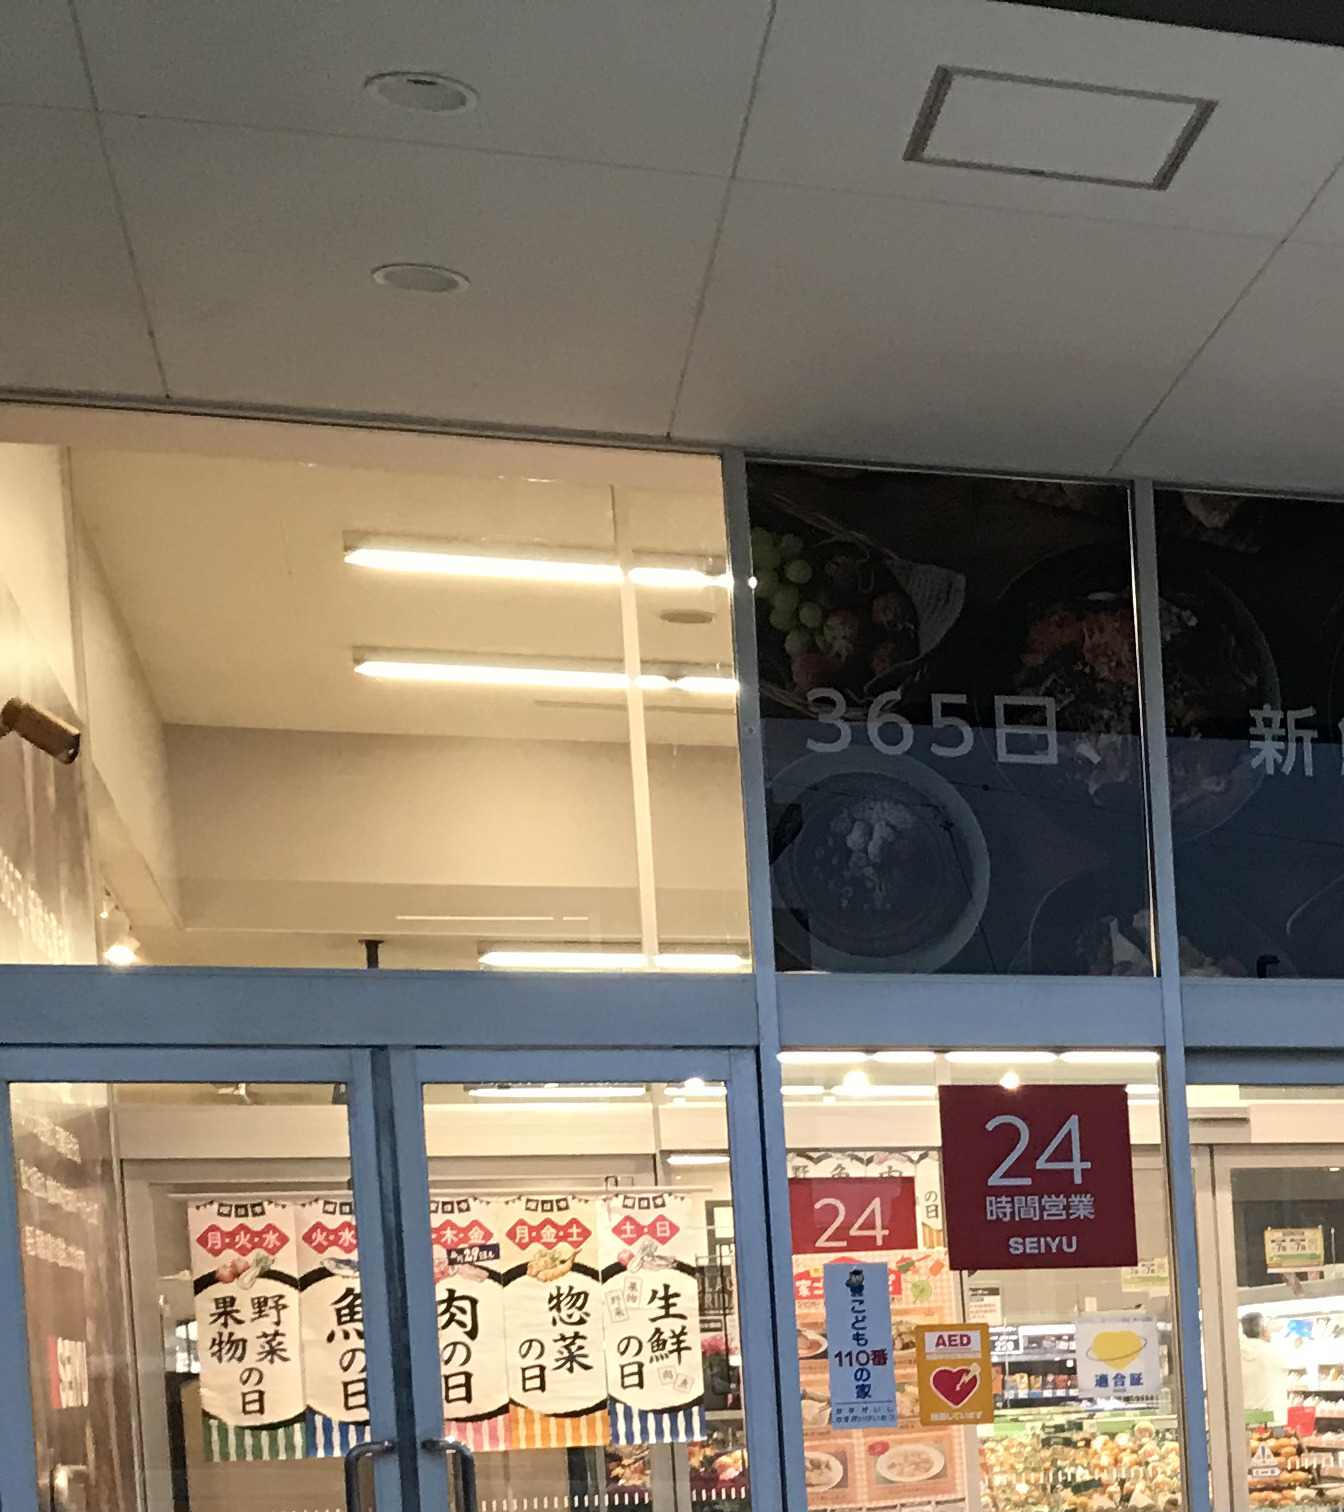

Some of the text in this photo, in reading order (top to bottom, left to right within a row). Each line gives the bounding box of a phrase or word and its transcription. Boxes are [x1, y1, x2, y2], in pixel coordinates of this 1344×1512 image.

[985, 1114, 1091, 1187] 24
[620, 1220, 671, 1240] 土・日
[814, 1197, 890, 1248] 24
[985, 1194, 1095, 1222] 時間営業
[1008, 1236, 1077, 1255] SEIYU
[209, 1295, 248, 1365] 果物
[250, 1294, 291, 1365] 野菜
[547, 1285, 594, 1374] 惣菜
[647, 1283, 693, 1366] 生鮮
[935, 1333, 972, 1348] AED
[518, 1338, 547, 1393] の日
[616, 1335, 645, 1390] の日
[834, 1348, 888, 1367] 110番
[239, 1367, 265, 1416] の日
